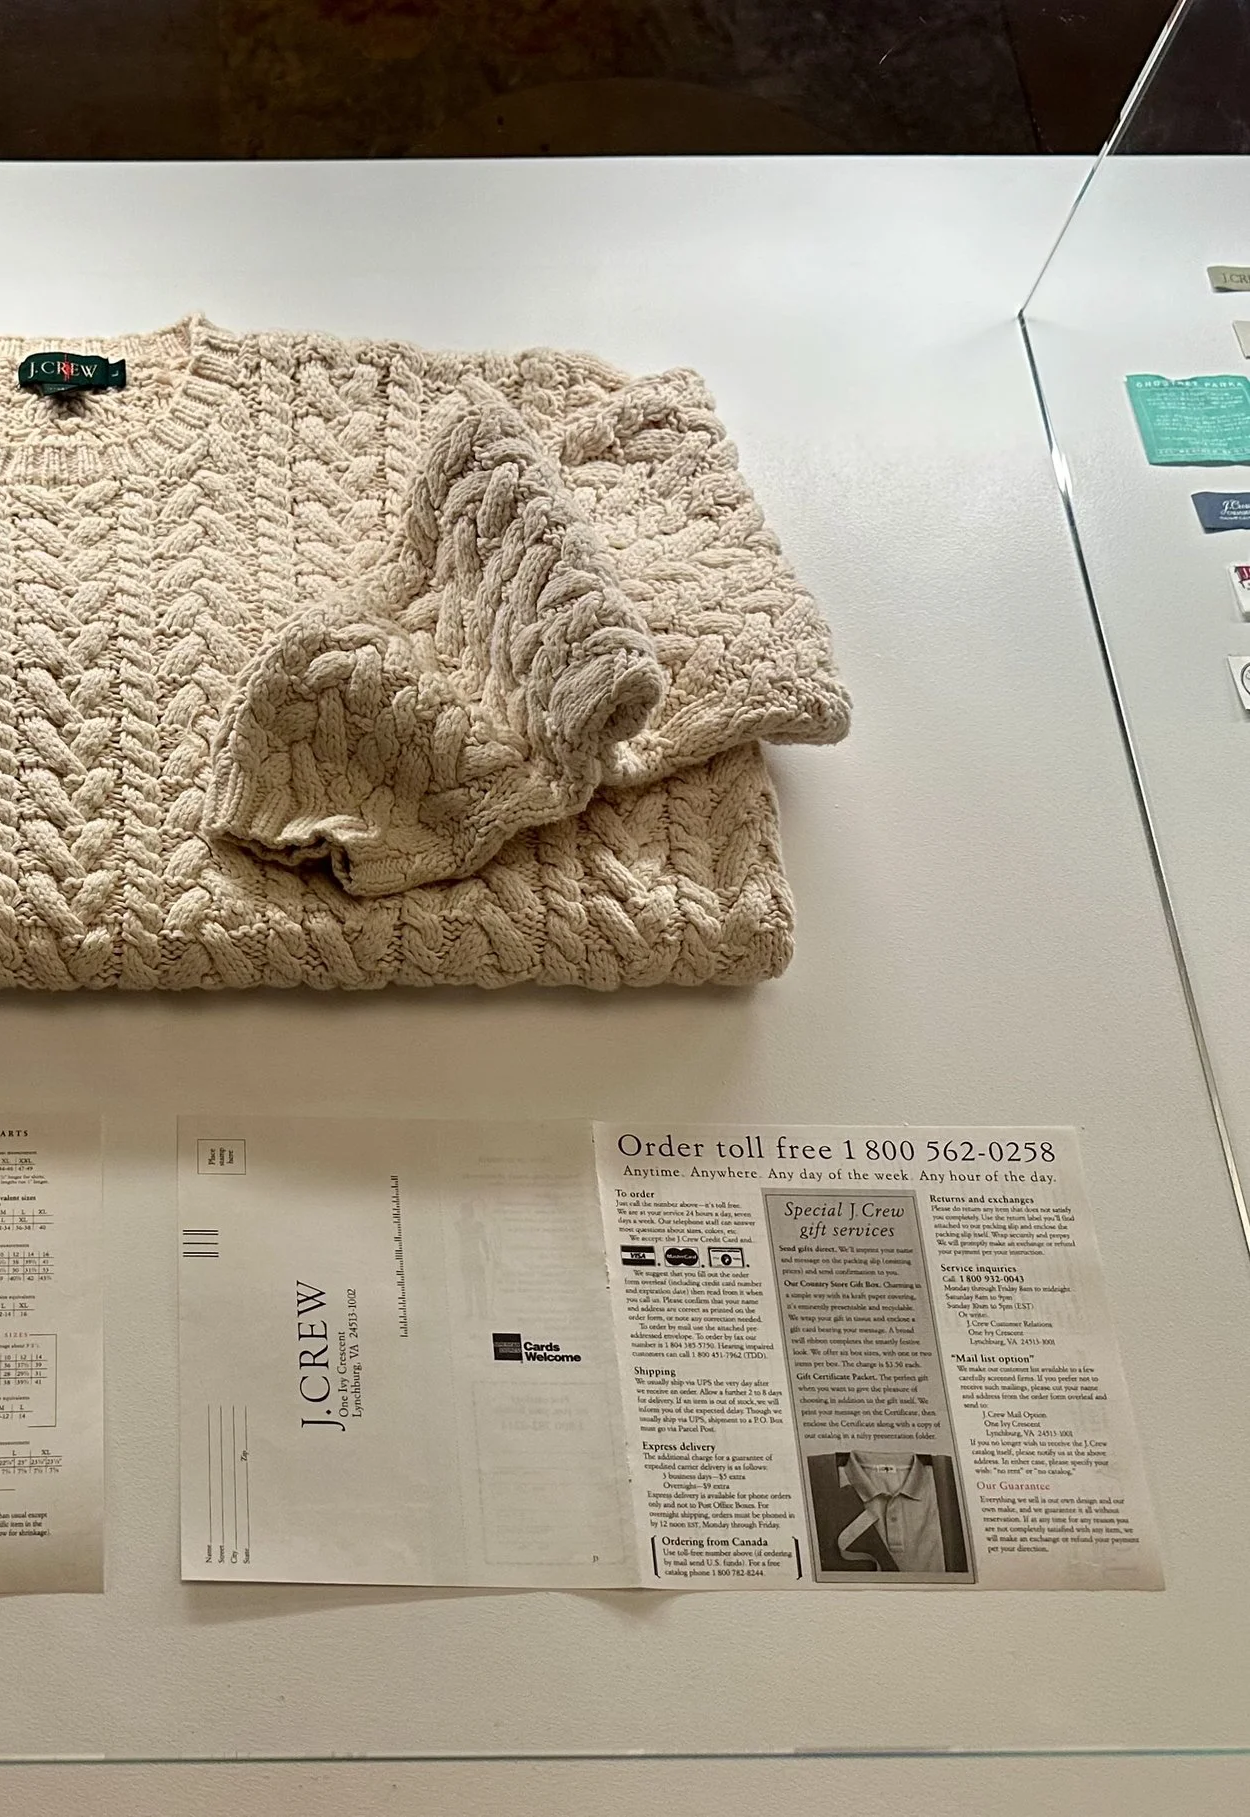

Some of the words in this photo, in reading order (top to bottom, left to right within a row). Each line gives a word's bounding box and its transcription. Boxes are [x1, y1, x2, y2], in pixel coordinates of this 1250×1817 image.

[28, 361, 97, 378] J.CREW
[618, 1134, 704, 1157] Order
[716, 1136, 764, 1159] toll
[776, 1136, 832, 1160] free
[843, 1140, 855, 1160] 1
[866, 1140, 915, 1161] 800
[927, 1140, 1055, 1162] 562-0258
[624, 1166, 686, 1179] Anytime.
[691, 1167, 762, 1180] Anywhere.
[769, 1168, 793, 1181] Any
[800, 1169, 822, 1182] day
[829, 1168, 843, 1179] of
[848, 1169, 869, 1180] the
[874, 1170, 913, 1180] week.
[920, 1171, 944, 1183] Any
[950, 1171, 980, 1182] hour
[986, 1171, 1000, 1182] of
[1004, 1171, 1025, 1182] the
[1031, 1172, 1056, 1184] day.
[615, 1189, 627, 1198] To
[630, 1190, 655, 1198] order
[930, 1195, 965, 1203] Returns
[968, 1195, 985, 1203] and
[988, 1196, 1034, 1205] exchanges
[784, 1201, 843, 1219] Special
[800, 1221, 827, 1239] gift
[833, 1223, 895, 1237] services
[941, 1264, 973, 1272] Service
[976, 1265, 1017, 1274] inquiries
[347, 1289, 358, 1338] 24513-1002
[337, 1331, 347, 1375] Crescent
[350, 1344, 359, 1359] VA
[524, 1342, 560, 1351] Cards
[297, 1280, 345, 1432] J.CREW
[525, 1352, 581, 1361] Welcome
[981, 1355, 995, 1363] list
[634, 1367, 676, 1377] Shipping
[338, 1377, 349, 1392] Ivy
[351, 1362, 364, 1417] Lynchburg,
[339, 1396, 348, 1417] One
[642, 1441, 677, 1452] Express
[680, 1442, 716, 1452] delivery
[977, 1481, 996, 1491] Our
[999, 1481, 1051, 1491] Guarantee
[662, 1537, 704, 1548] Ordering
[707, 1537, 730, 1546] from
[732, 1538, 768, 1547] Canada
[231, 1551, 239, 1564] City
